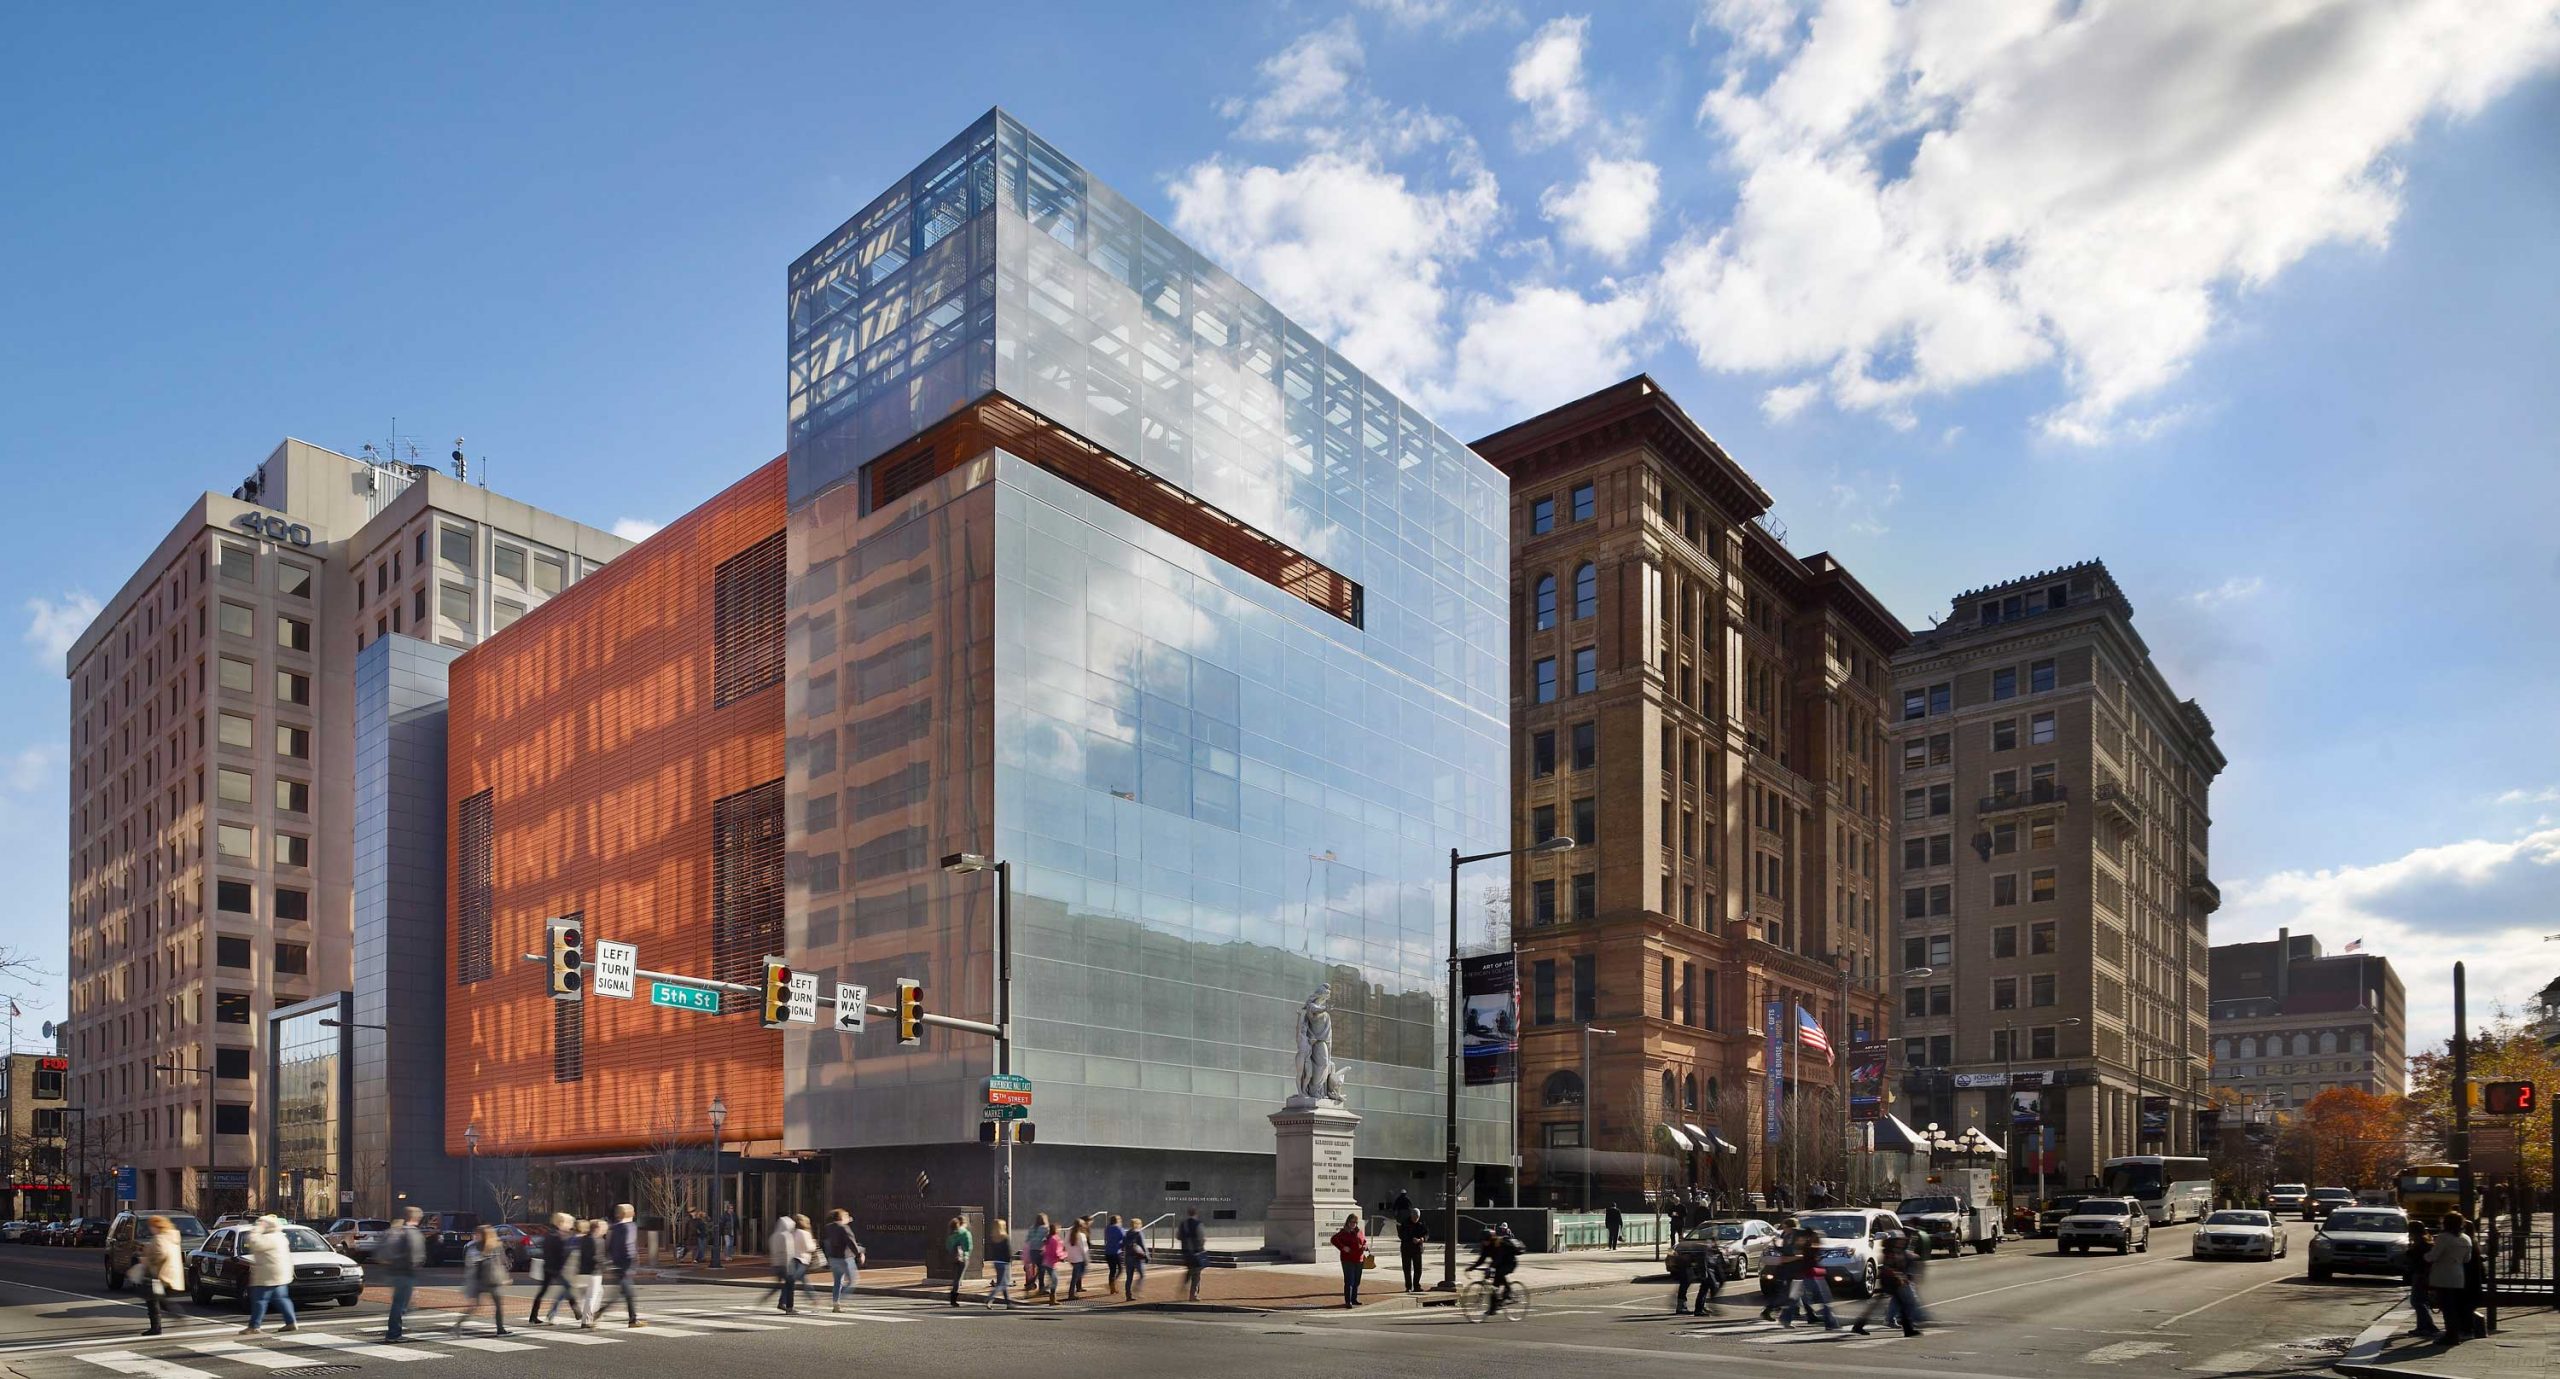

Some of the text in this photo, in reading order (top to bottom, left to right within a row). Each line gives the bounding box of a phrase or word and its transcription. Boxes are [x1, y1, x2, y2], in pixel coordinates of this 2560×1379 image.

[241, 510, 312, 548] 400
[603, 948, 630, 961] LEFT
[602, 962, 629, 976] TURN
[598, 977, 630, 992] SIGNAL
[790, 979, 812, 990] LEFT
[661, 987, 711, 1007] 5th St
[790, 991, 813, 1003] TURN
[842, 988, 861, 1001] ONE
[841, 1002, 861, 1014] WAY
[43, 1057, 68, 1070] FOX
[992, 1093, 1007, 1102] 5TH
[2519, 1086, 2531, 1107] 2
[984, 1109, 1004, 1118] MARKET
